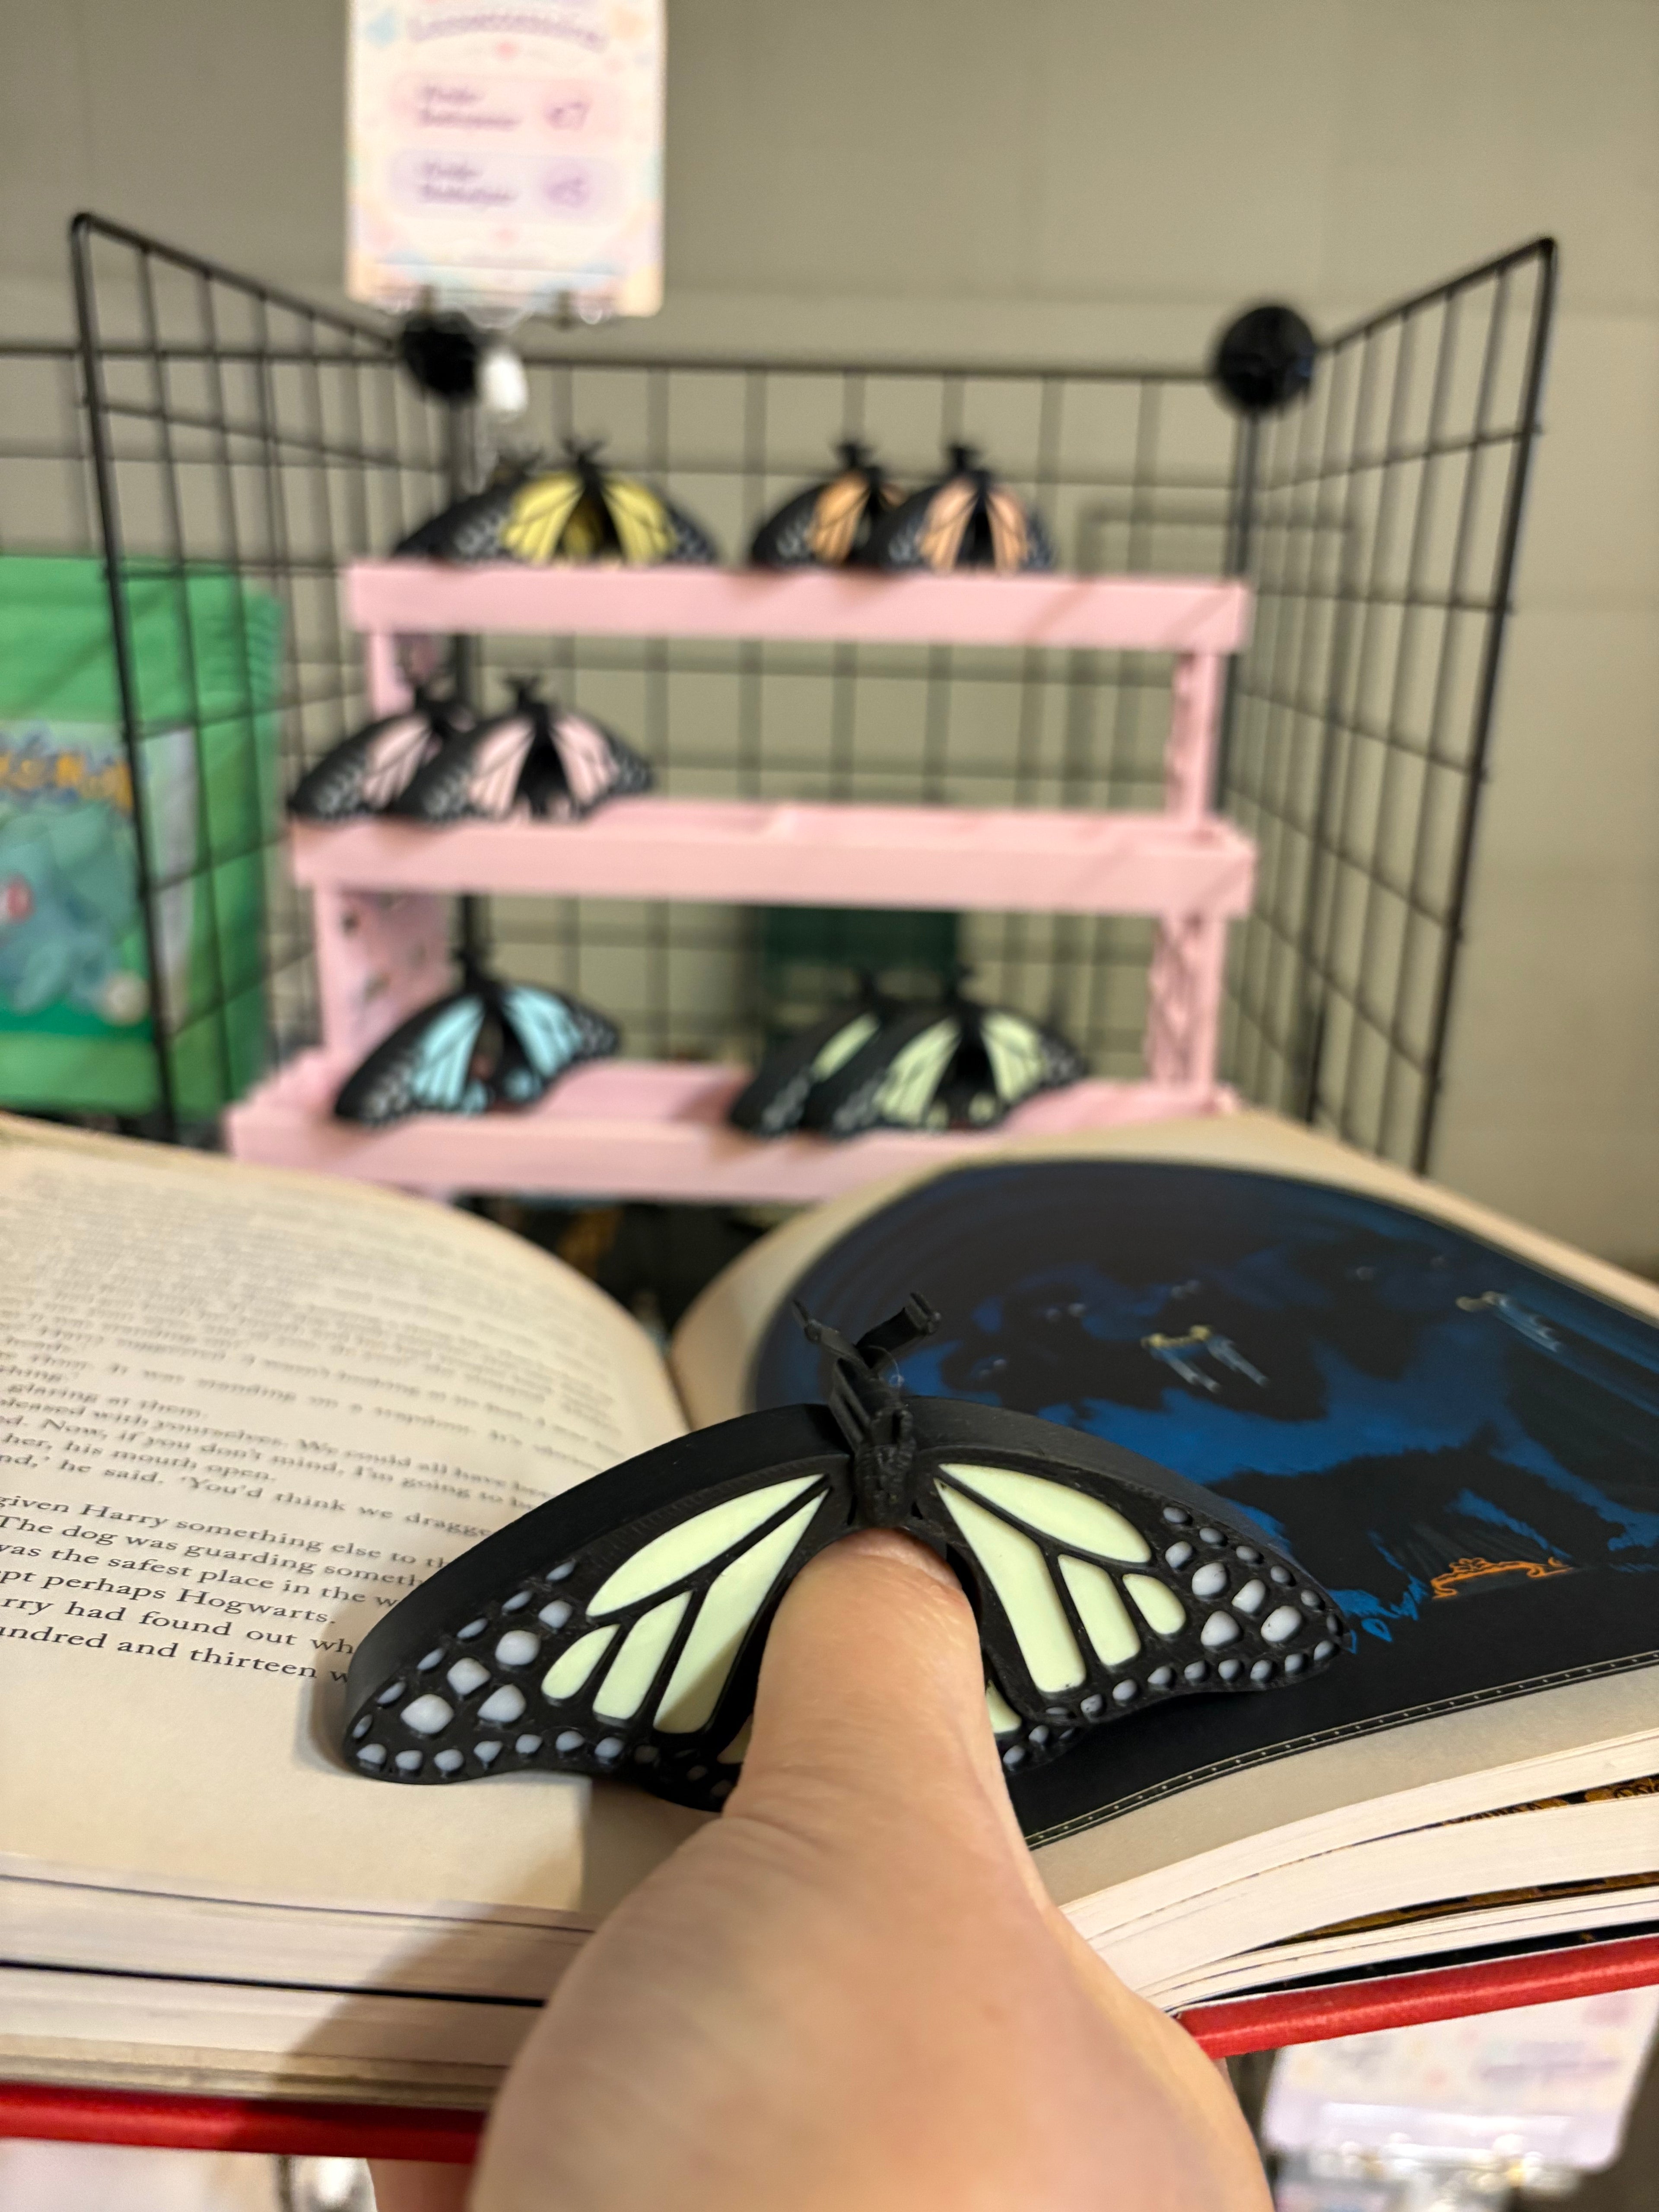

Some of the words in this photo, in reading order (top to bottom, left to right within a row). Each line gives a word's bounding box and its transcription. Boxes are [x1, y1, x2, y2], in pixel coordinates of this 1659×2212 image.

[3, 1433, 53, 1450] her,
[65, 1440, 104, 1456] his
[112, 1450, 197, 1469] mouth
[0, 1454, 50, 1468] nd,'
[60, 1459, 92, 1471] he
[104, 1469, 164, 1484] said.
[275, 1492, 346, 1512] think
[358, 1506, 394, 1519] we
[404, 1512, 493, 1537] dragge
[0, 1515, 54, 1533] The
[62, 1525, 118, 1545] dog
[126, 1535, 178, 1551] was
[184, 1544, 318, 1575] guarding
[324, 1565, 423, 1587] someth
[80, 1503, 170, 1528] Harry
[176, 1520, 324, 1553] something
[331, 1542, 381, 1558] else
[391, 1552, 416, 1564] to
[40, 1576, 166, 1601] perhaps
[176, 1588, 337, 1624] Hogwarts.
[51, 1548, 100, 1564] the
[108, 1557, 193, 1577] safest
[197, 1569, 274, 1589] place
[282, 1580, 311, 1595] in
[321, 1586, 366, 1603] the
[0, 1598, 54, 1615] rry
[64, 1601, 127, 1621] had
[138, 1611, 232, 1636] found
[246, 1630, 298, 1646] out
[118, 1641, 179, 1658] and
[190, 1647, 318, 1679] thirteen
